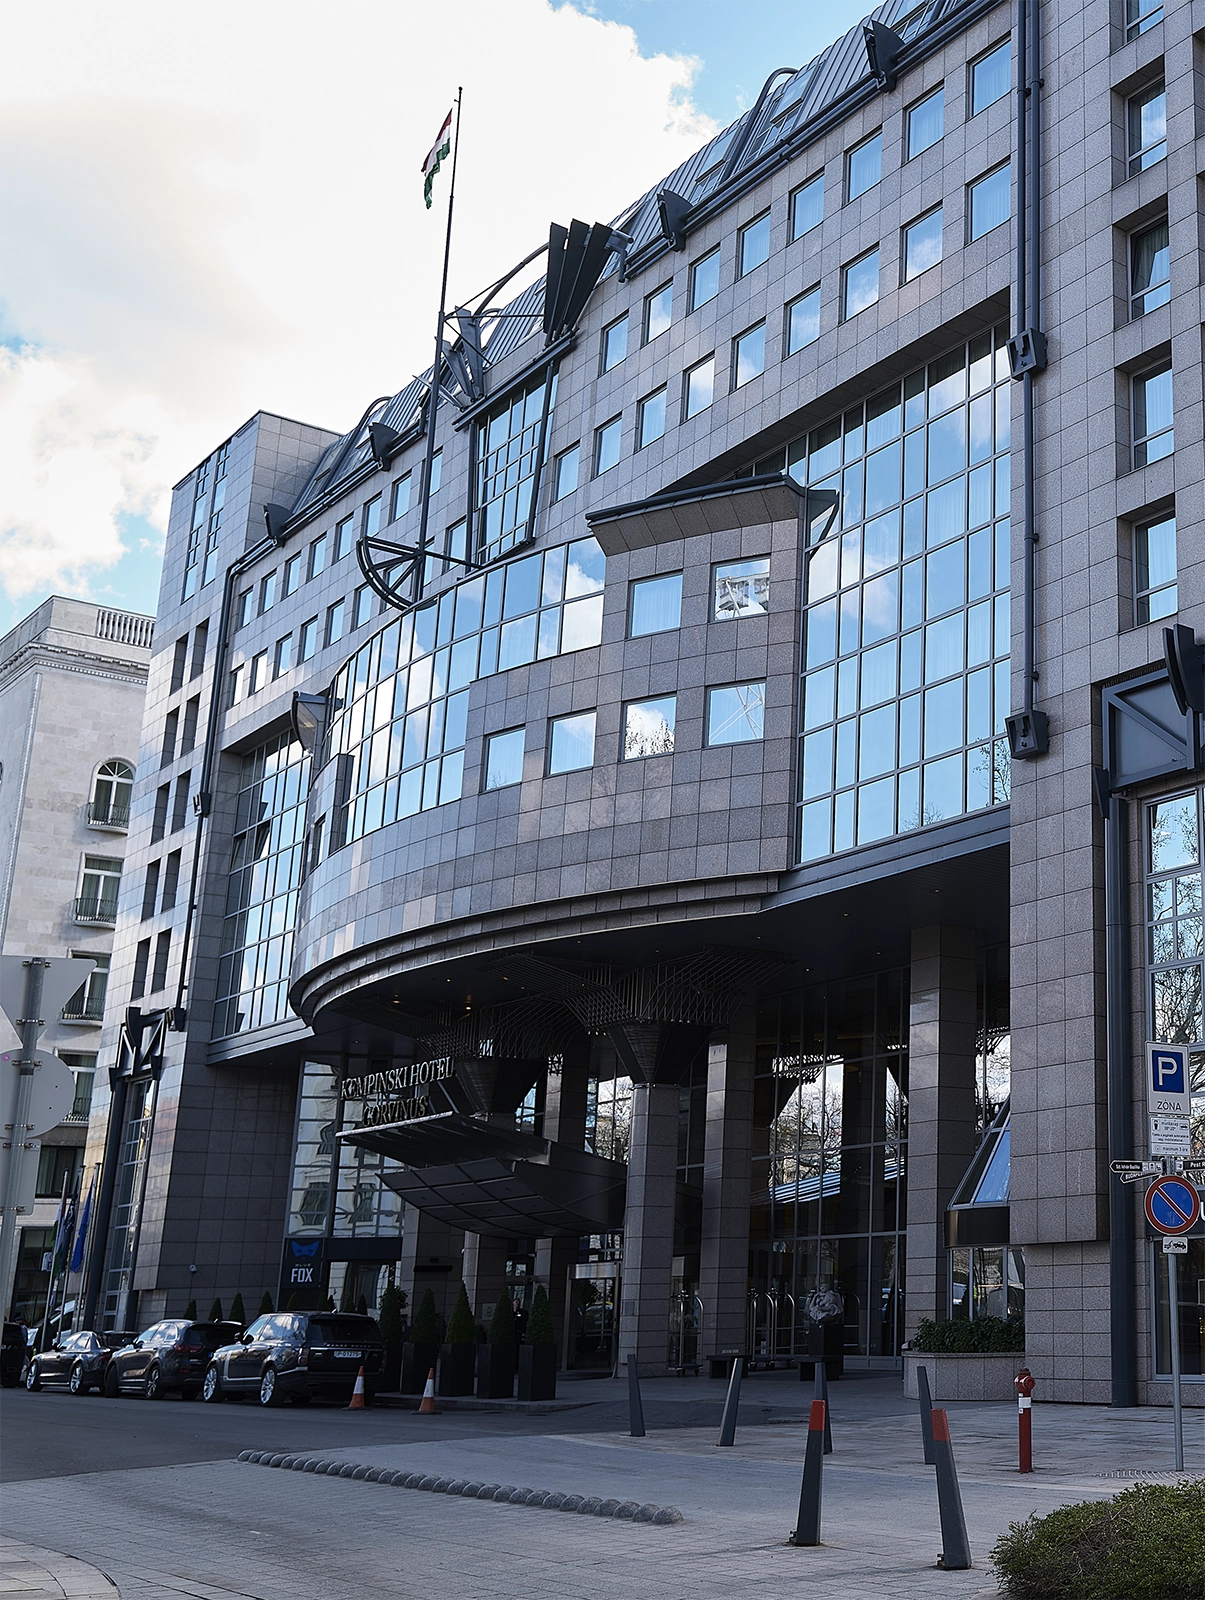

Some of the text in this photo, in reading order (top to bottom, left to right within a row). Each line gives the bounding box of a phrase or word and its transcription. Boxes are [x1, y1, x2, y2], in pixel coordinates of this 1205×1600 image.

[340, 1056, 455, 1100] KEMPINSKI HOTEL
[1157, 1056, 1178, 1086] P
[1157, 1098, 1182, 1112] ZÓNA
[291, 1268, 313, 1283] FOX
